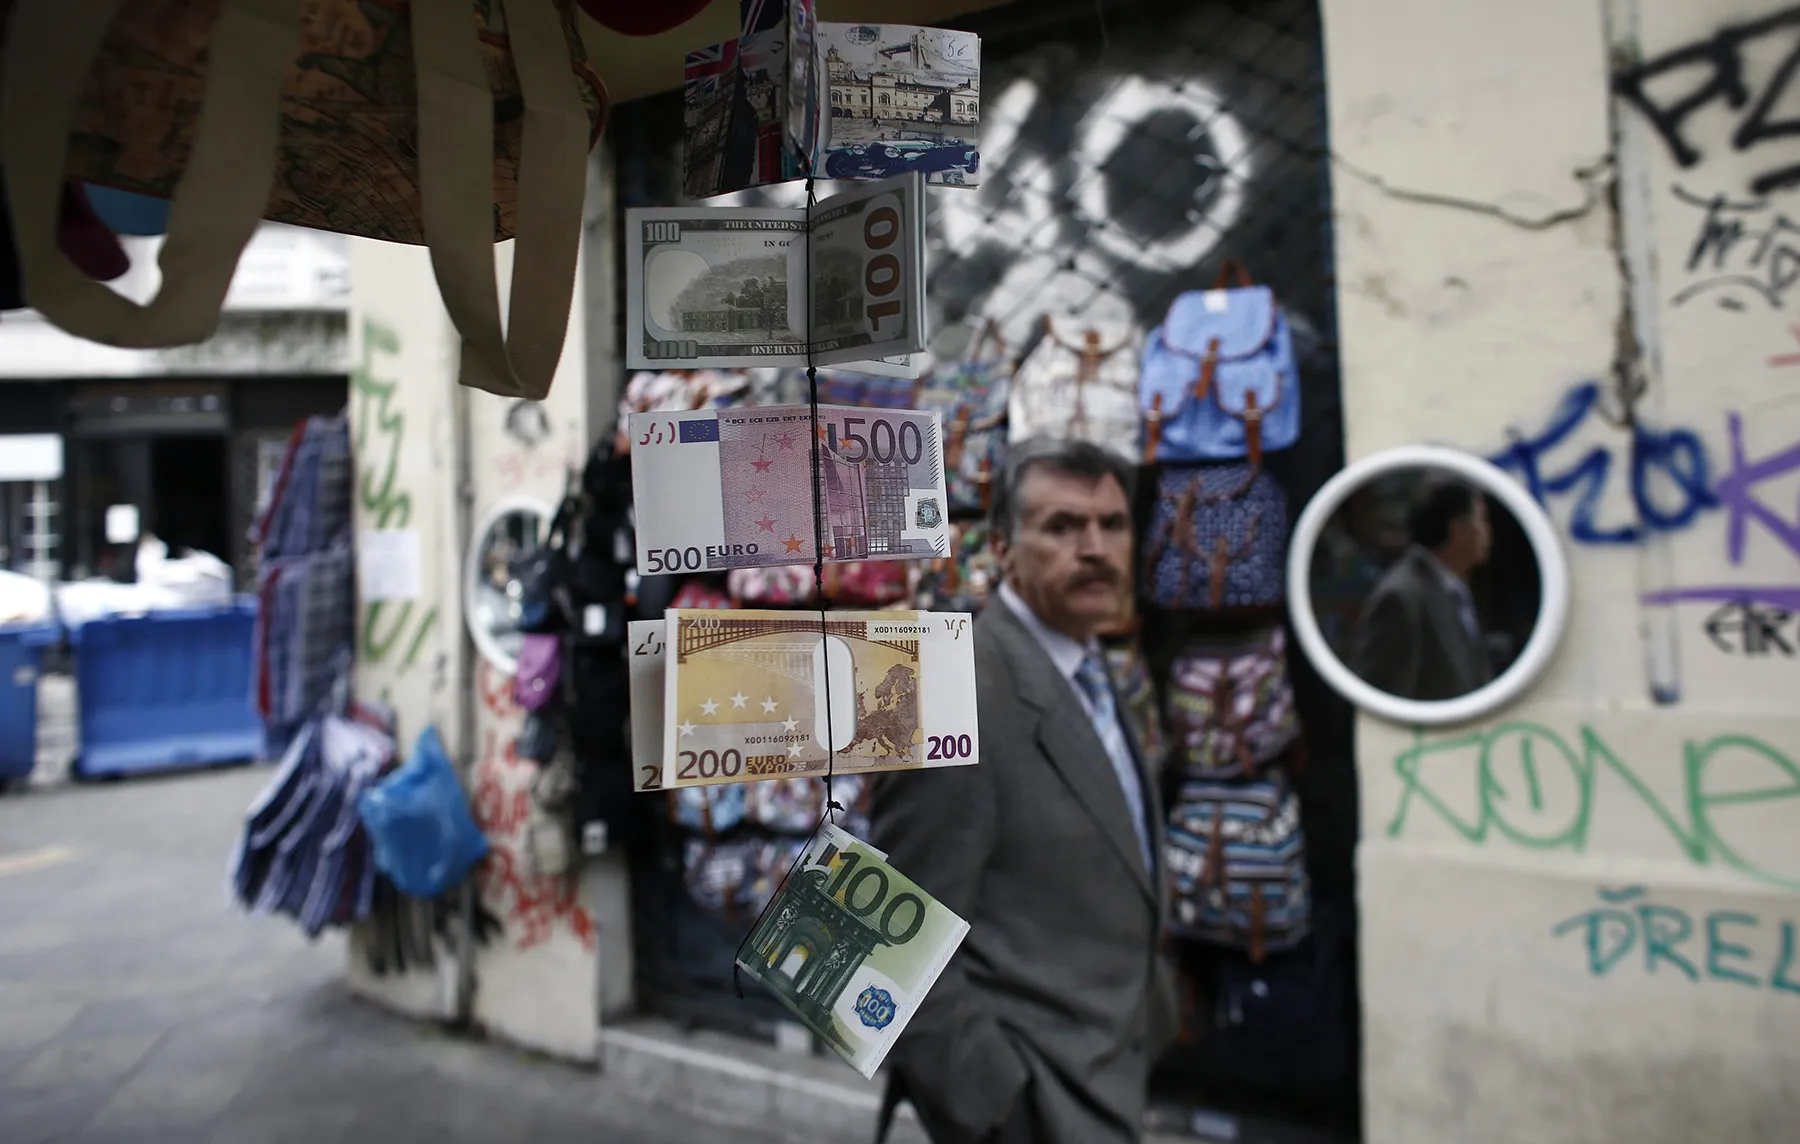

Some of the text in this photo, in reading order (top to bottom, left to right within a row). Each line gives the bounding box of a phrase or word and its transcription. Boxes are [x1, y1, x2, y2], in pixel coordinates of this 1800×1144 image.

[646, 221, 681, 242] 100
[723, 220, 747, 230] THE
[748, 220, 789, 230] UNITED
[864, 205, 900, 333] 100
[751, 344, 774, 355] ONE
[843, 416, 923, 466] 500
[647, 546, 702, 573] 500
[706, 542, 760, 558] EURO
[687, 614, 721, 630] 200
[874, 626, 931, 634] X00116092181
[744, 734, 811, 744] X00116092181
[926, 733, 972, 761] 200
[677, 748, 742, 780] 200
[745, 754, 786, 766] EURO
[641, 764, 663, 790] 2
[826, 850, 926, 946] 100
[860, 993, 891, 1020] 100
